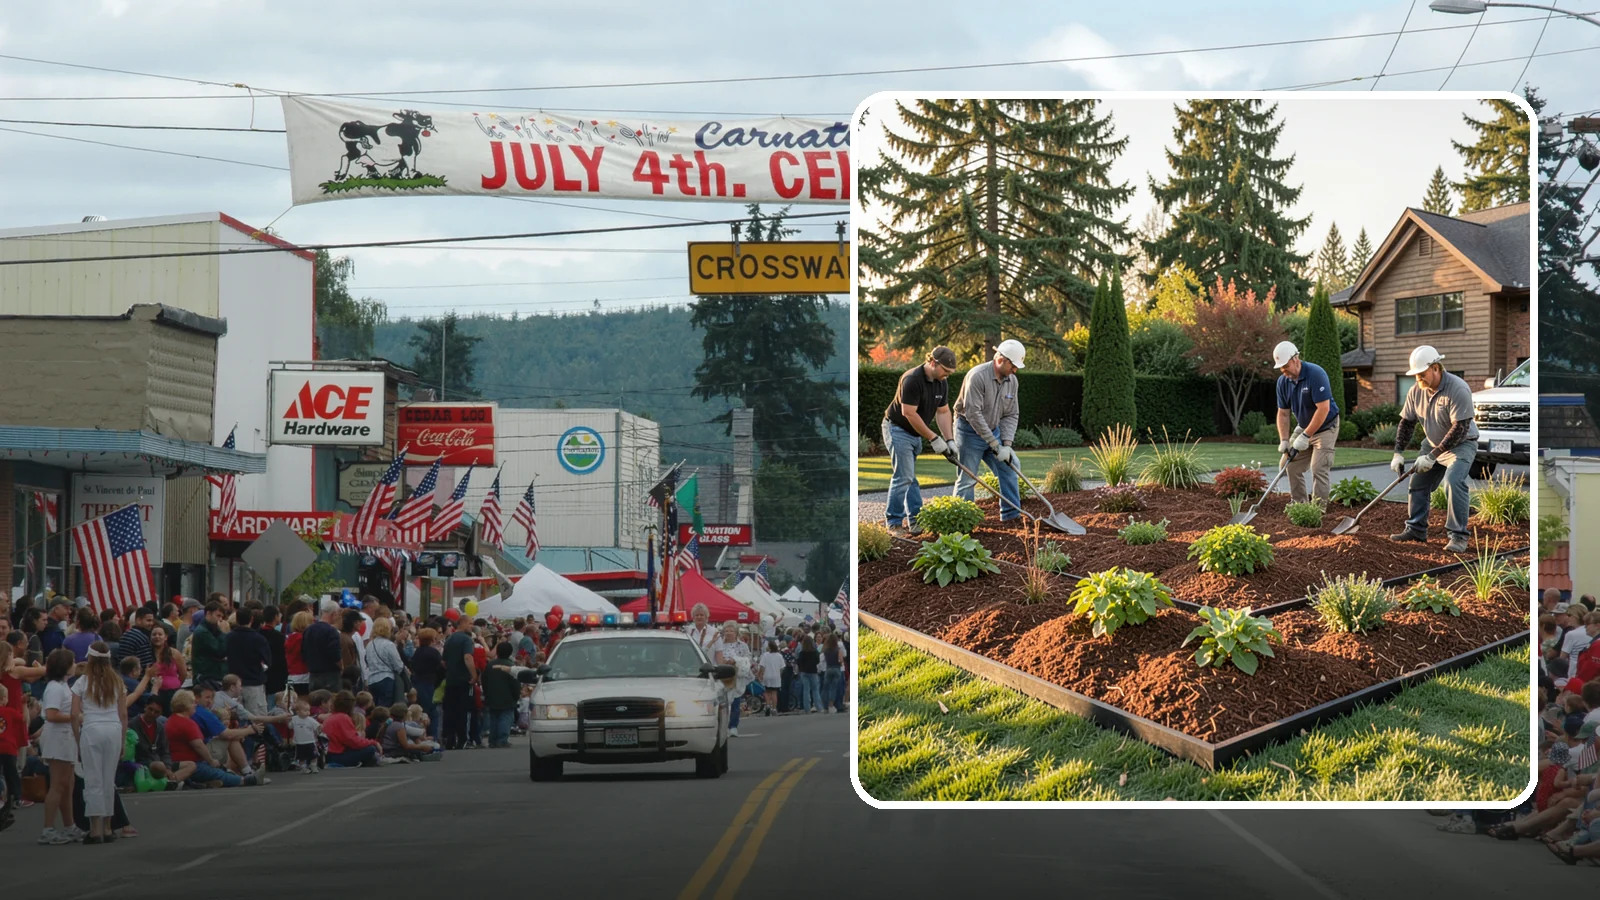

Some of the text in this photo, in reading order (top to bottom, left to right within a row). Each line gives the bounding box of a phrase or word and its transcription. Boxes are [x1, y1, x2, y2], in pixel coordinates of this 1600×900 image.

[481, 141, 605, 192] JULY
[632, 150, 746, 197] 4th.
[697, 254, 850, 280] CROSSWA
[283, 380, 373, 420] ACE
[405, 409, 452, 422] CEDAR
[283, 420, 371, 436] Hardware
[95, 485, 124, 495] Vincent
[126, 486, 136, 495] de
[137, 486, 155, 495] Paul
[212, 514, 331, 536] HARDARE
[688, 526, 741, 535] CRNATION
[699, 535, 730, 543] GLASS
